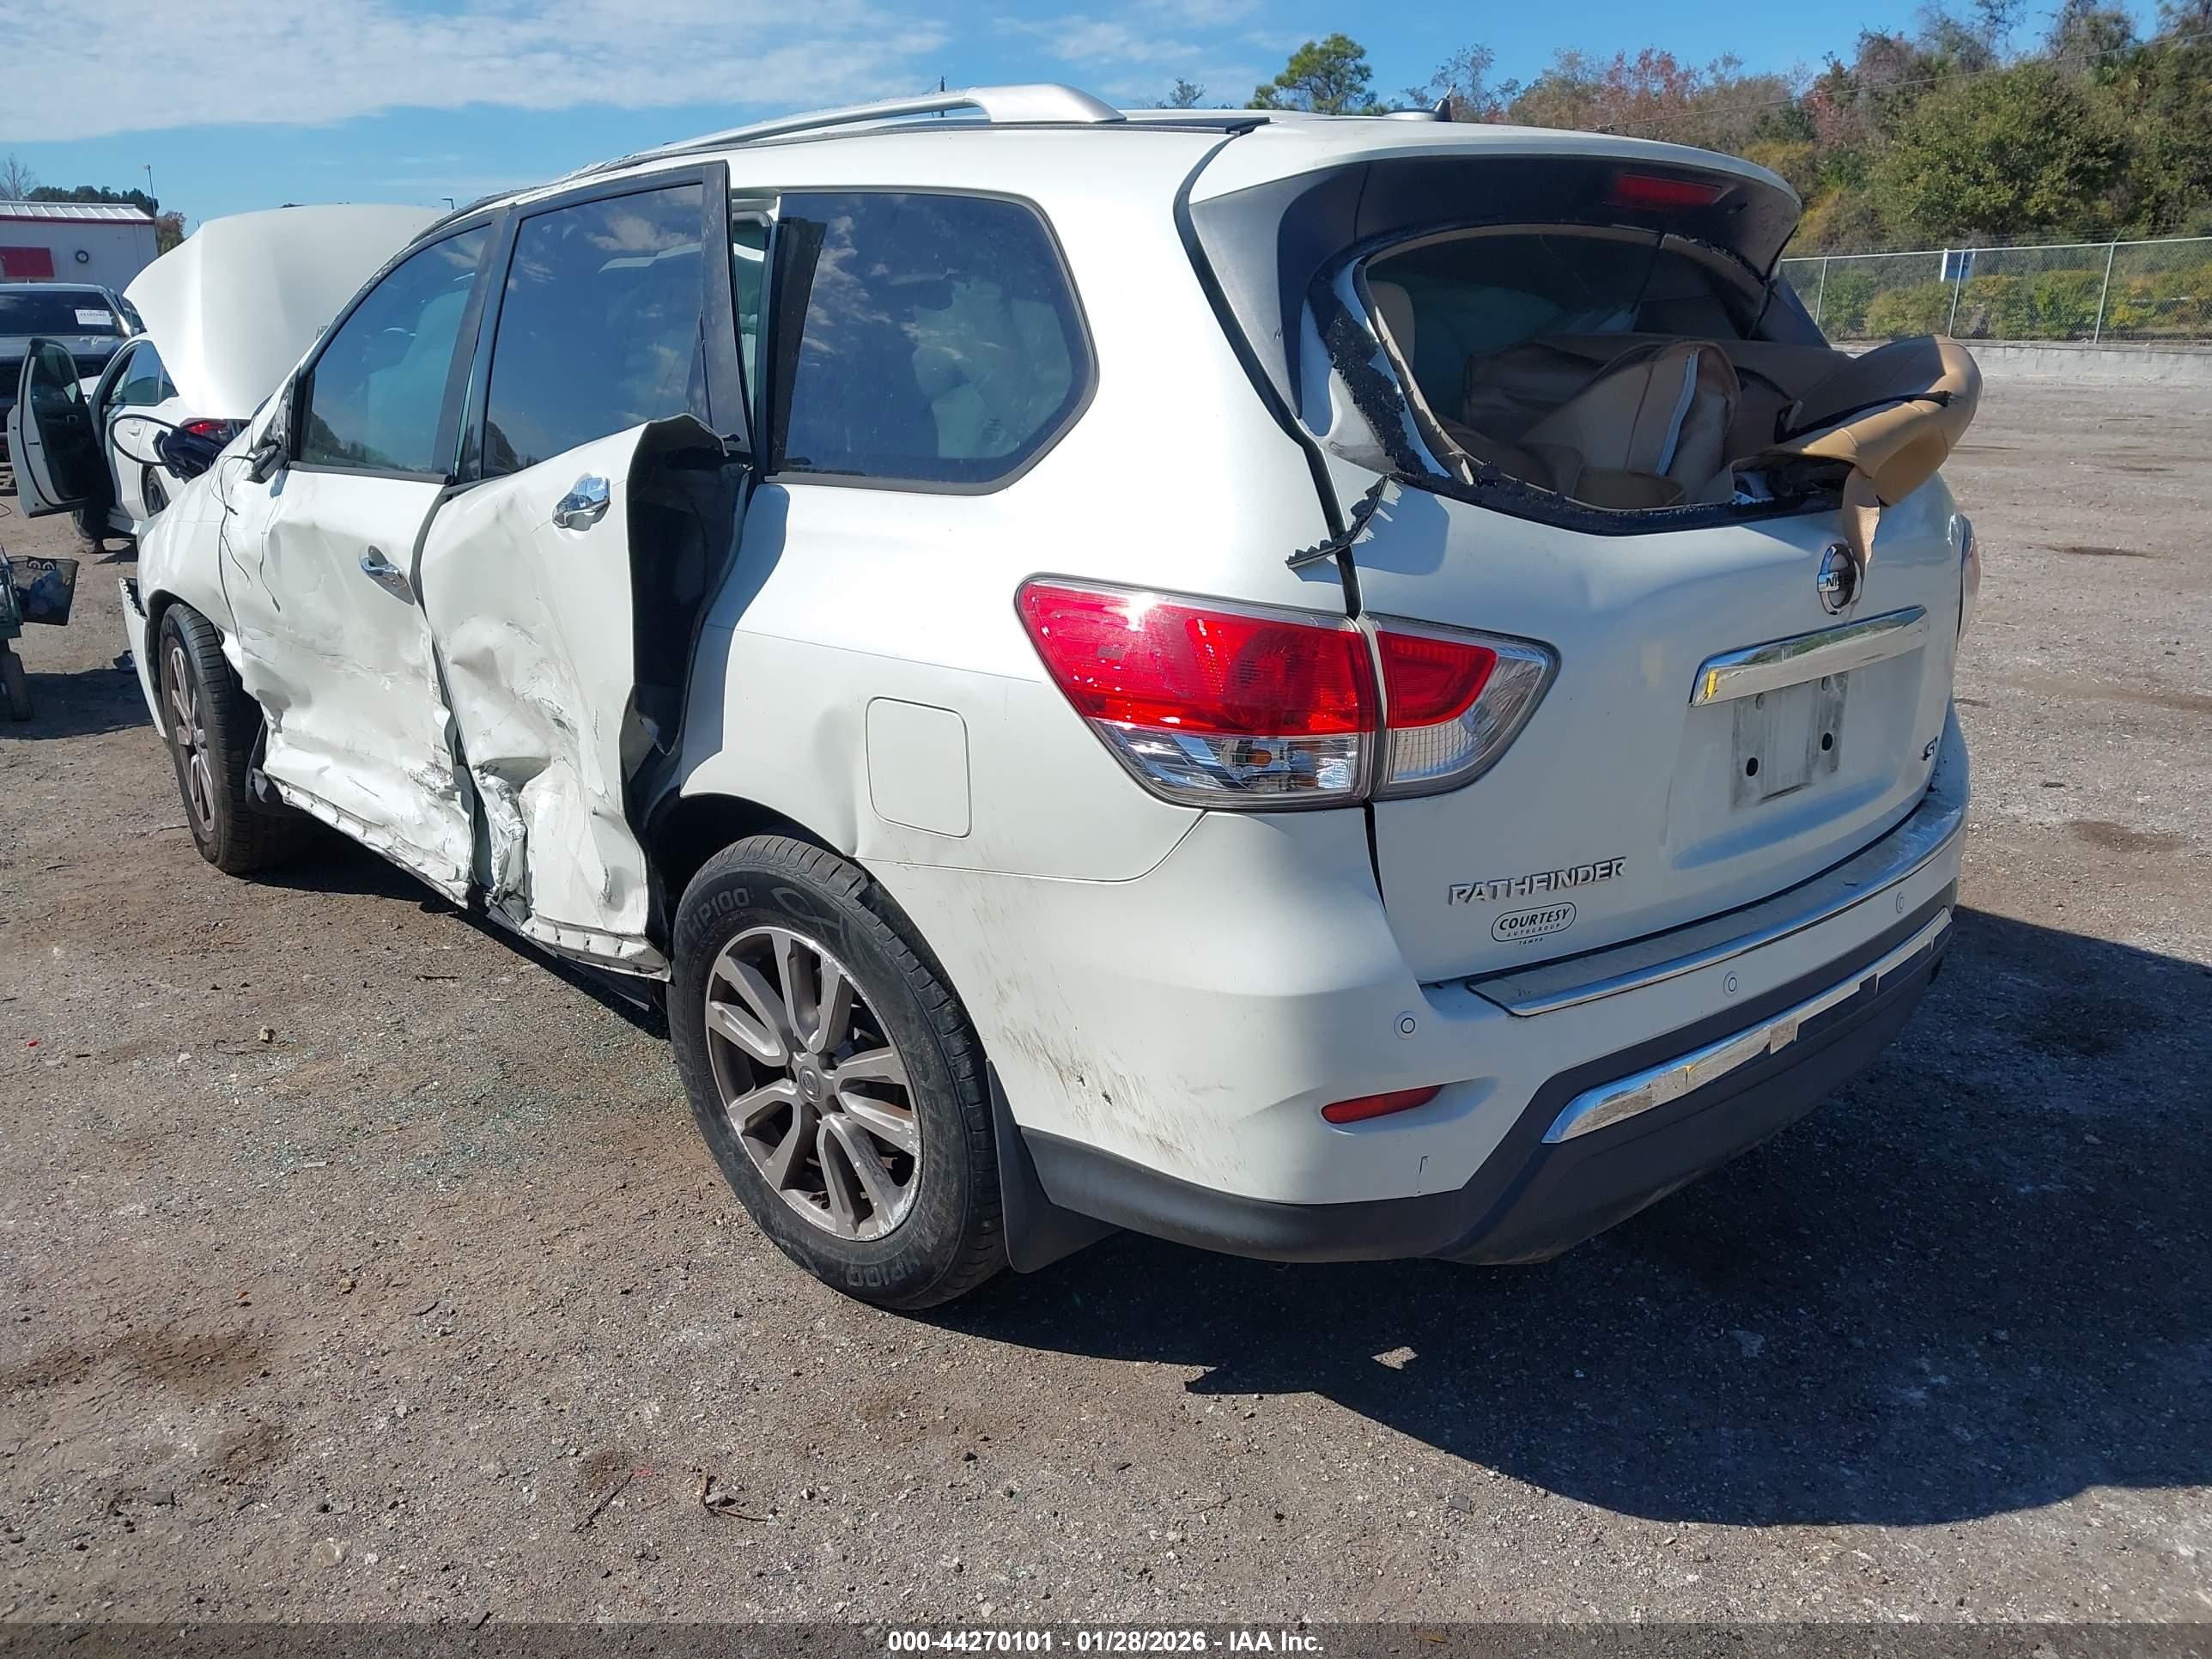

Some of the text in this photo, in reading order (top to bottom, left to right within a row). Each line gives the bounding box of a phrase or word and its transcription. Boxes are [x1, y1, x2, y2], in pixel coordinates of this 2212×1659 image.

[1448, 857, 1626, 905] PATHFINDER
[1499, 908, 1571, 931] COURTESY
[1506, 923, 1560, 938] AUTOGROUP
